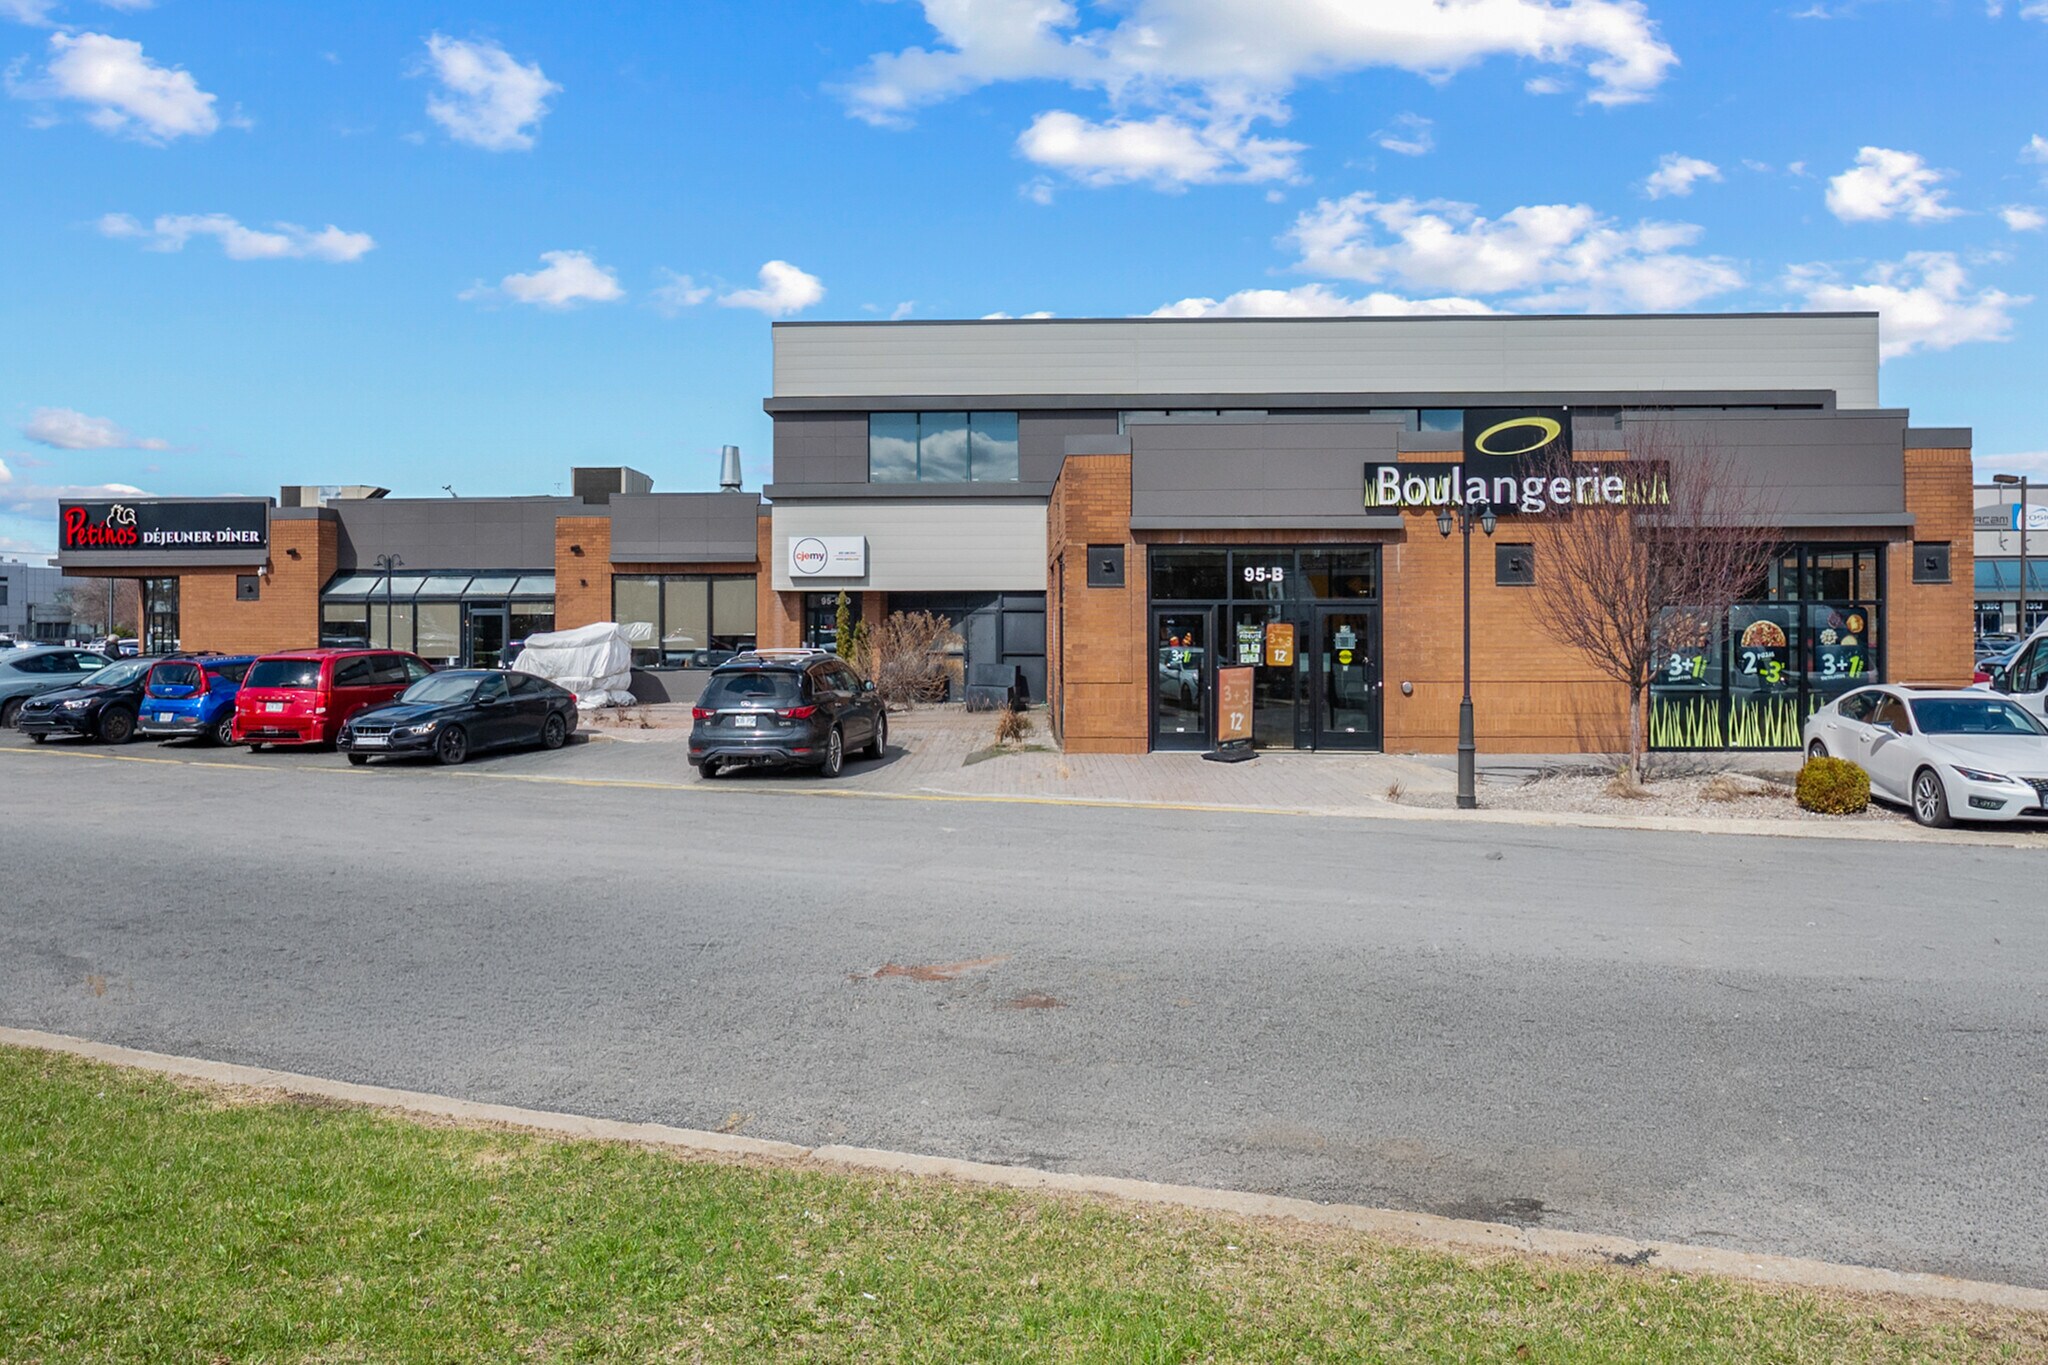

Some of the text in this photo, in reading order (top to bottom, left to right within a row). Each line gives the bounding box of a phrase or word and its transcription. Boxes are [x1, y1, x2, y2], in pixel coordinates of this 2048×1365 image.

[1377, 466, 1623, 513] Boulangerie
[64, 507, 137, 545] Petinos
[1244, 567, 1284, 582] 95-B
[1669, 653, 1702, 678] 3+1
[1742, 651, 1757, 674] 2
[1822, 653, 1860, 678] 3+1
